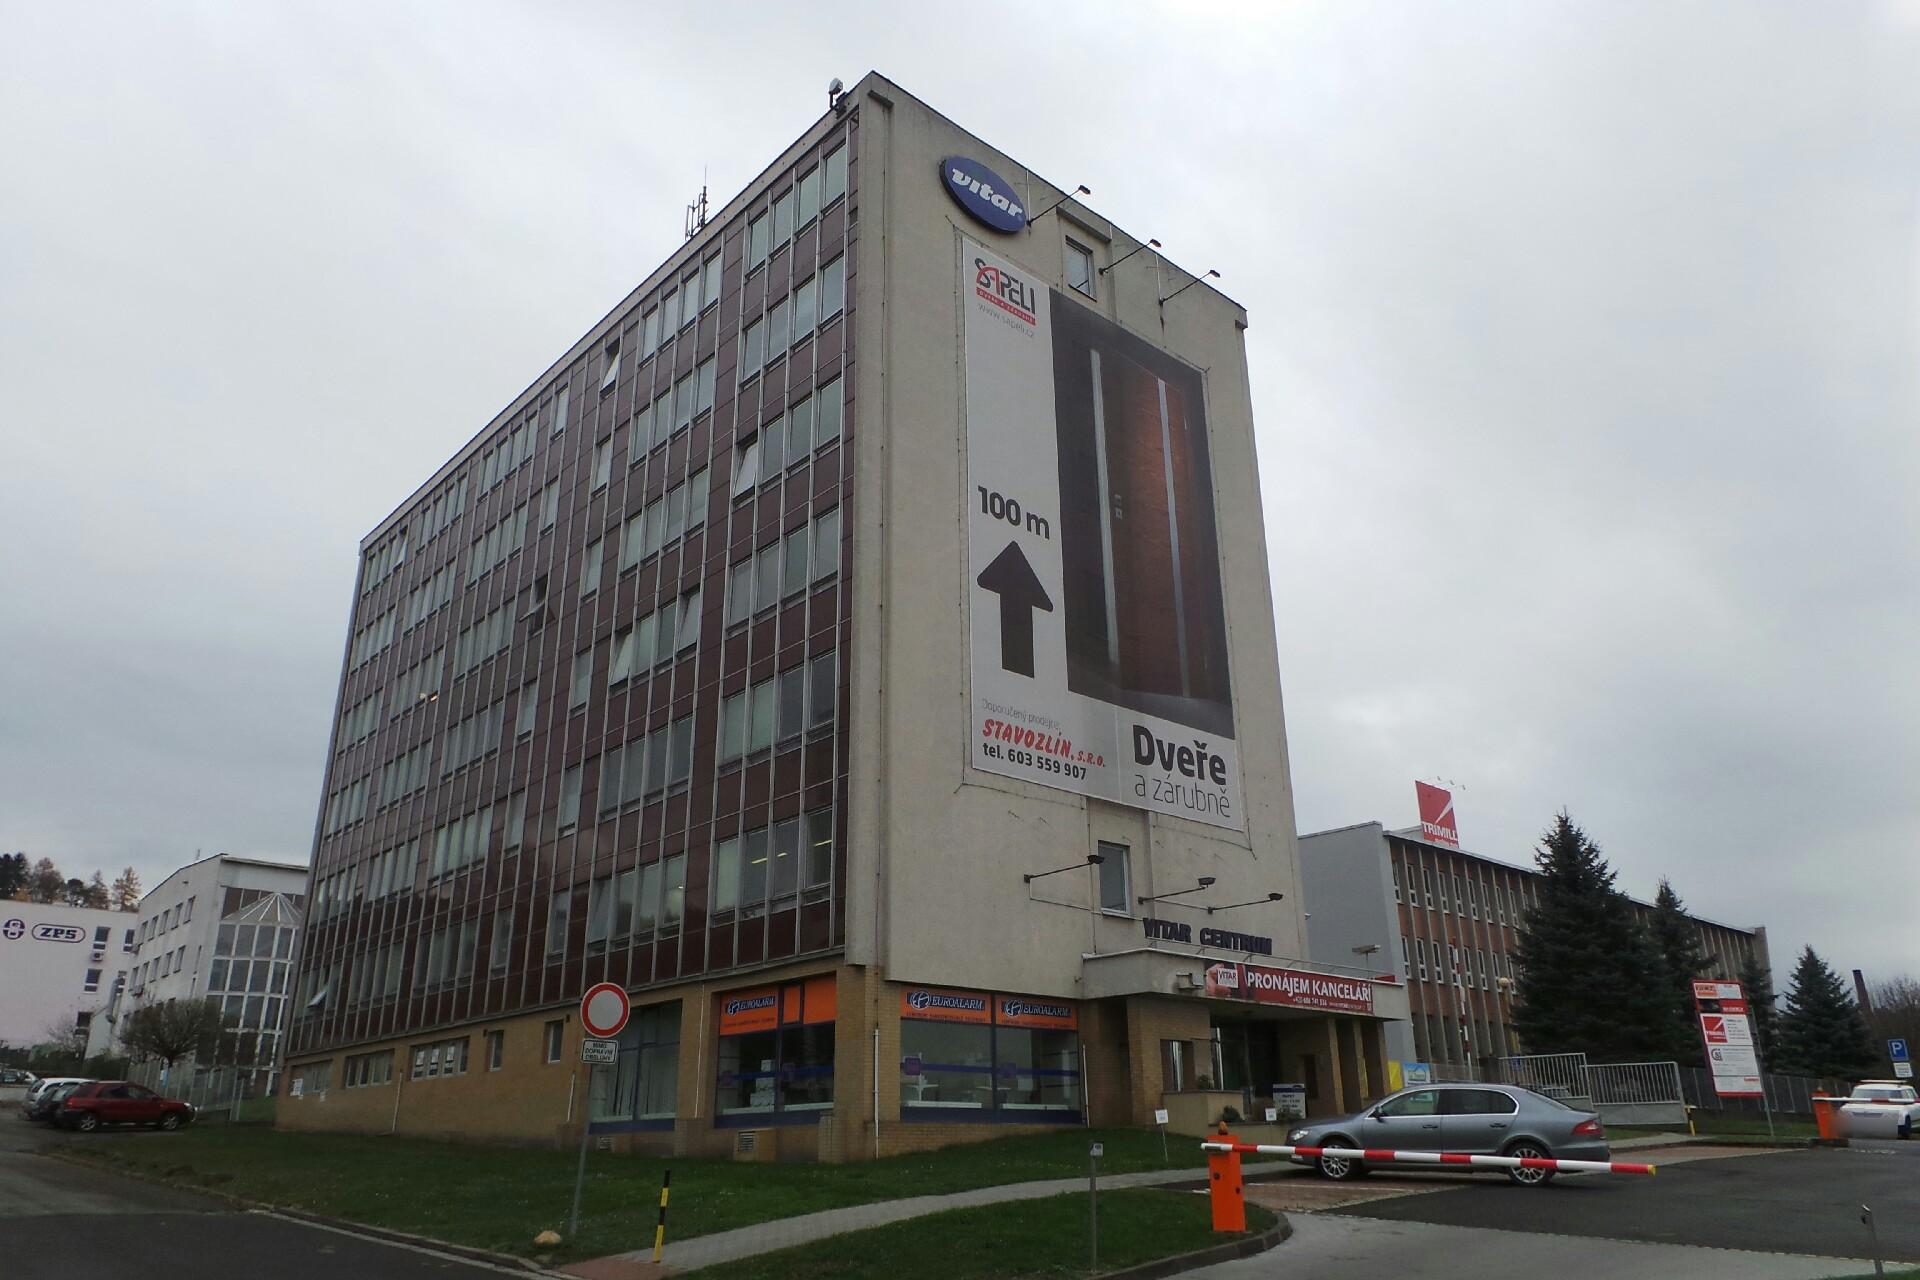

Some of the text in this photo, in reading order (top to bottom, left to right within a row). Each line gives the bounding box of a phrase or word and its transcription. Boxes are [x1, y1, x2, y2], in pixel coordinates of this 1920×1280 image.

[952, 168, 1023, 216] vitar
[974, 257, 1036, 315] SAPELI
[977, 485, 1050, 540] 100 m
[982, 742, 1087, 780] tel. 603 559 907
[1132, 724, 1226, 786] Dveře
[1135, 773, 1231, 818] a zárubně
[1421, 820, 1458, 841] TRIMILL
[40, 927, 78, 939] ZPS
[1142, 917, 1273, 956] VITAR CENTRUM
[1218, 970, 1237, 980] VITAR
[1247, 971, 1372, 1002] PRONÁJEM KANCELÁŘÍ
[932, 995, 983, 1010] EUROALARM
[1023, 1005, 1069, 1017] EUROALARM
[1891, 1042, 1903, 1056] P
